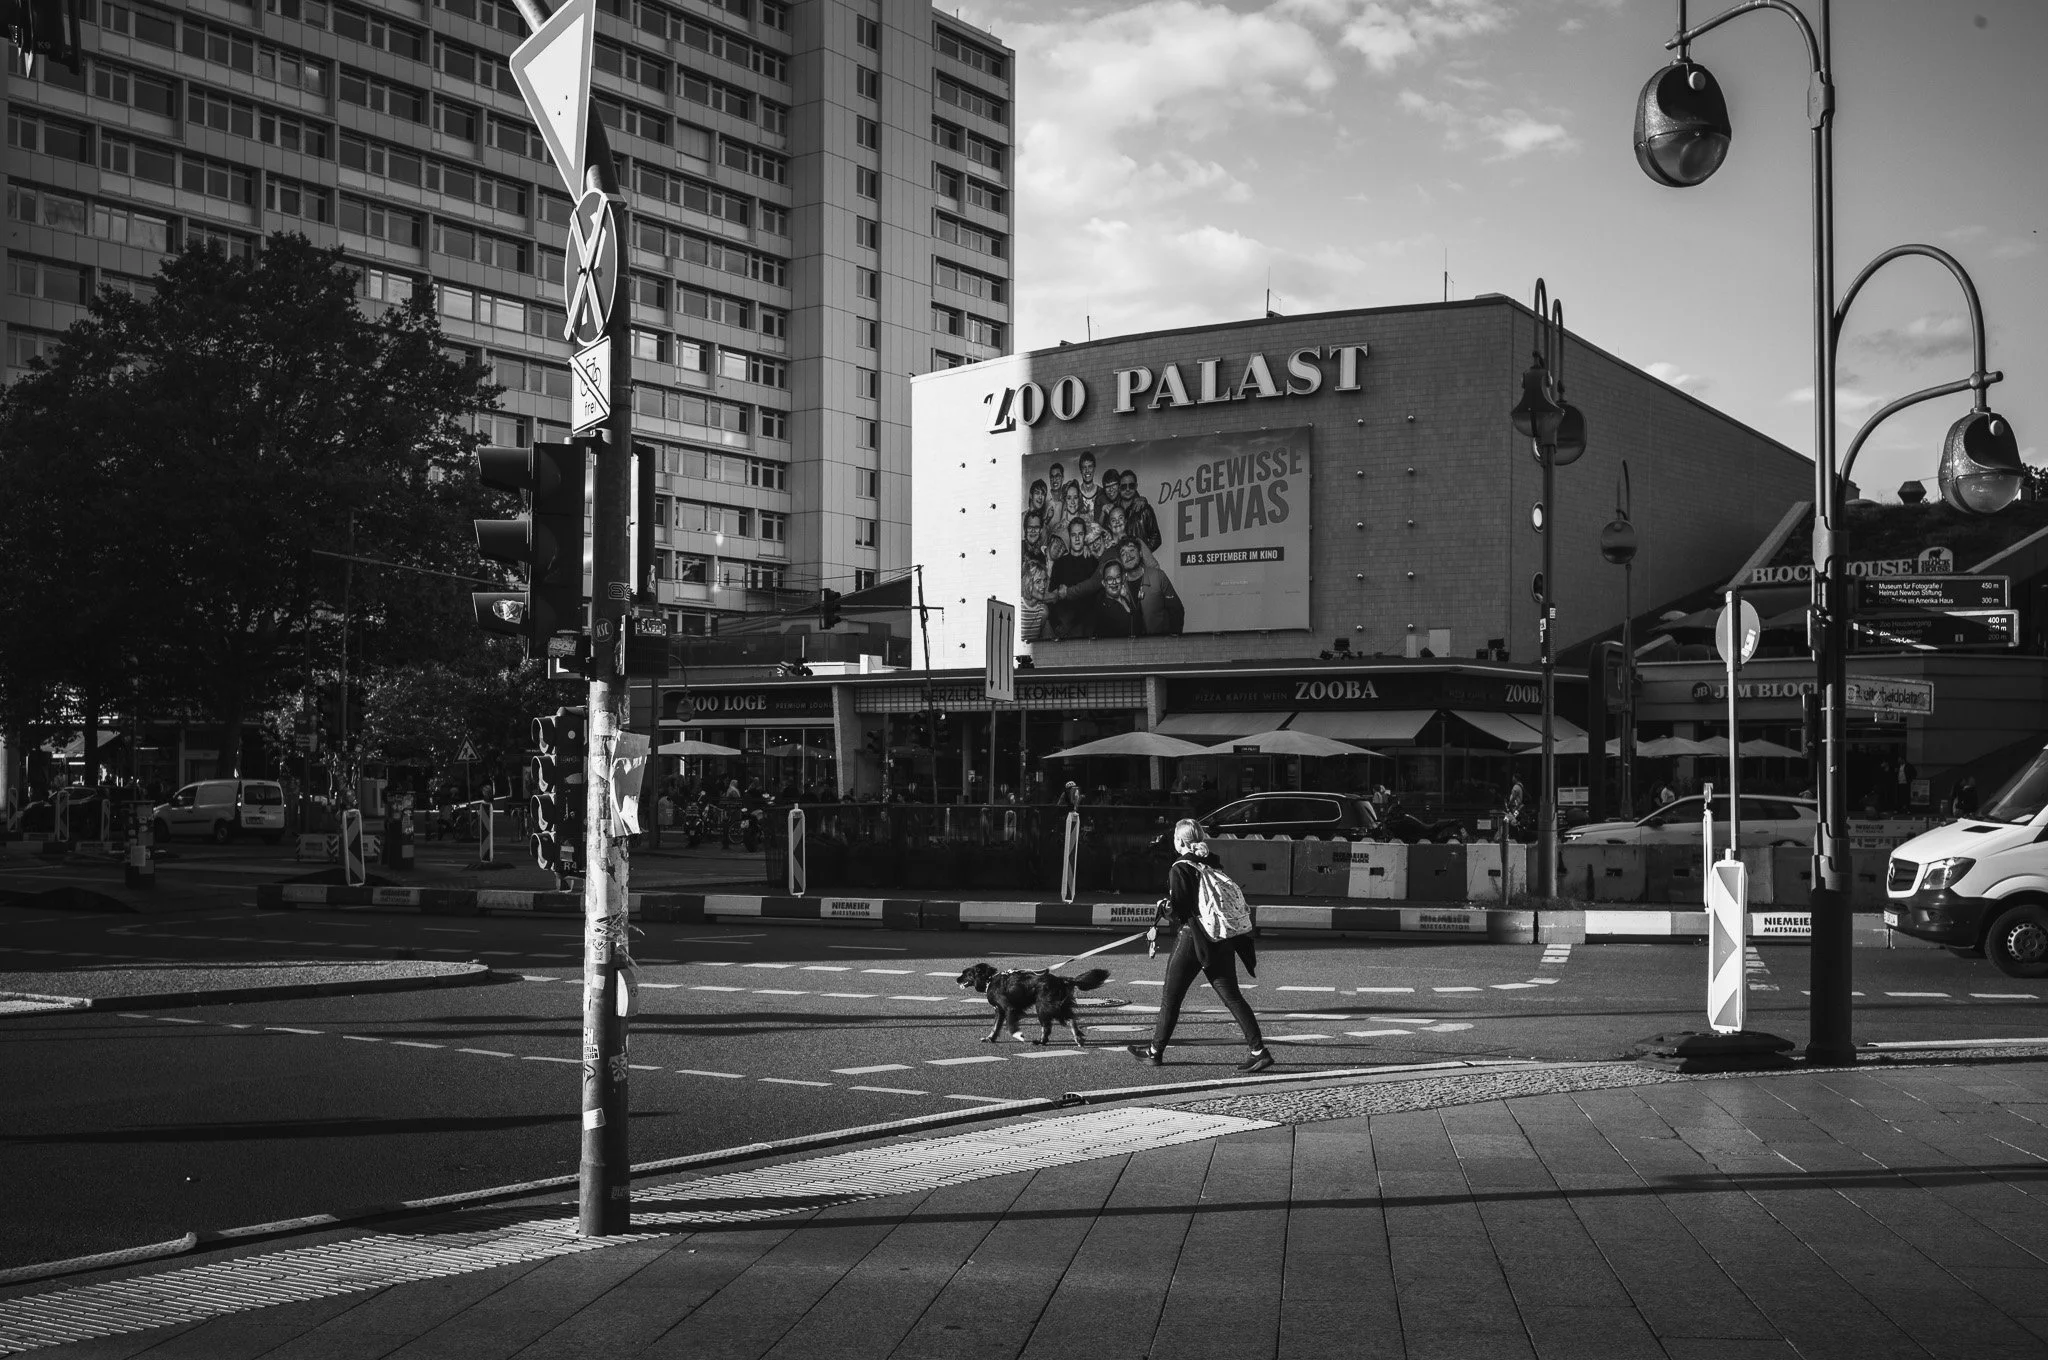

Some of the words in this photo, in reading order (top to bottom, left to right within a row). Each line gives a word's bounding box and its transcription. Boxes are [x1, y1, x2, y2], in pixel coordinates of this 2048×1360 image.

[983, 375, 1086, 435] ZOO
[1112, 342, 1369, 413] PALAST
[1158, 476, 1195, 504] DAS
[1195, 446, 1303, 495] GEWISSE
[1177, 479, 1290, 543] ETWAS
[1186, 554, 1197, 564] AB
[1198, 554, 1205, 563] 3.
[1206, 551, 1247, 562] SEPTEMBER
[1249, 550, 1258, 560] IM
[1260, 549, 1278, 560] KINO
[1912, 582, 1939, 590] Fotografie
[1988, 616, 2000, 624] 400
[1295, 680, 1379, 700] ZOOBA
[1505, 684, 1541, 703] ZOOB
[1715, 684, 1752, 699] JM
[724, 695, 767, 711] LOGE
[563, 861, 577, 871] R4
[832, 901, 870, 910] NIEMEIER
[1111, 907, 1156, 916] NIEMEIER
[1764, 917, 1812, 926] NIEMEIE
